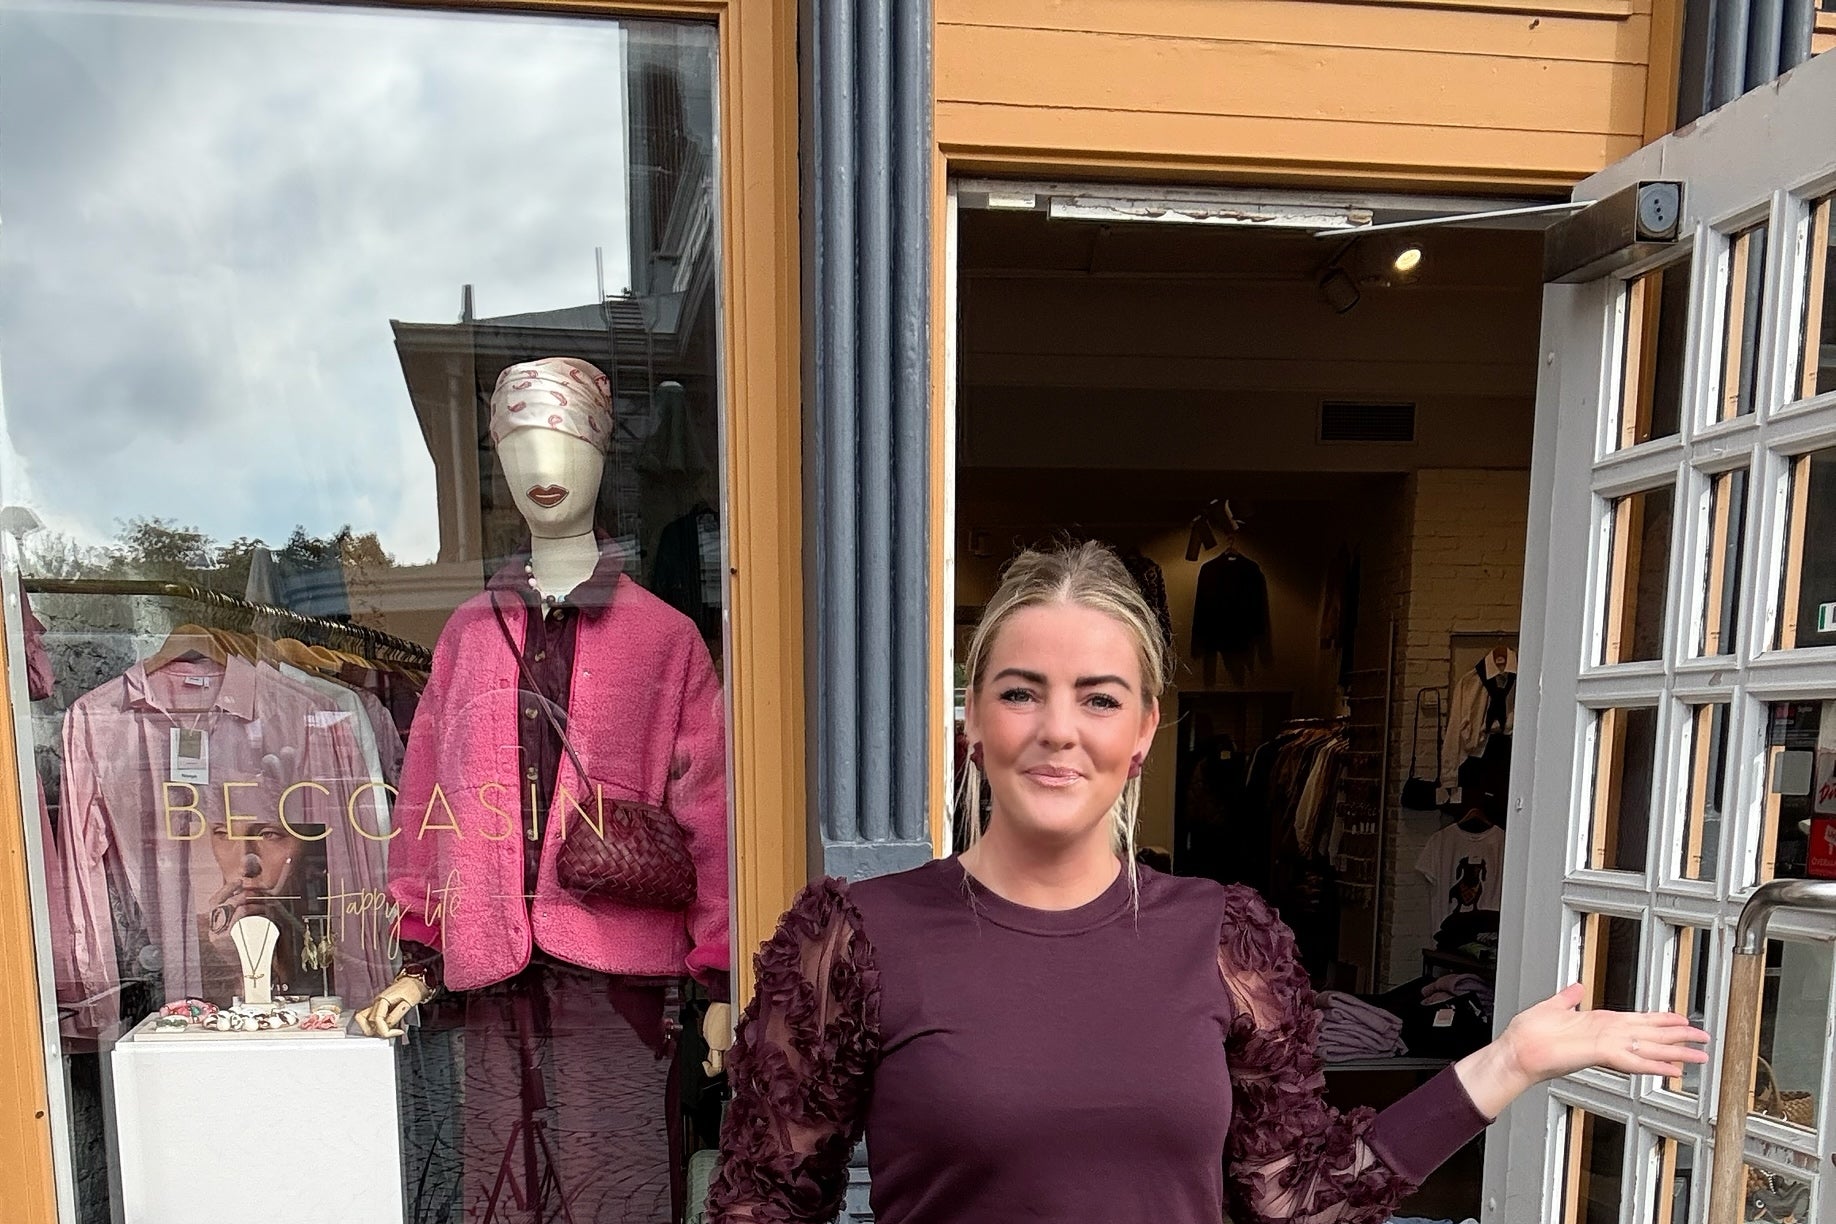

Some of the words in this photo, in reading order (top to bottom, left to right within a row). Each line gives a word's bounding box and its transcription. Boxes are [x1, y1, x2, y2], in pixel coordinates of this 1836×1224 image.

[161, 781, 605, 842] BECCASIN
[317, 872, 412, 961] Happy
[424, 868, 468, 949] life
